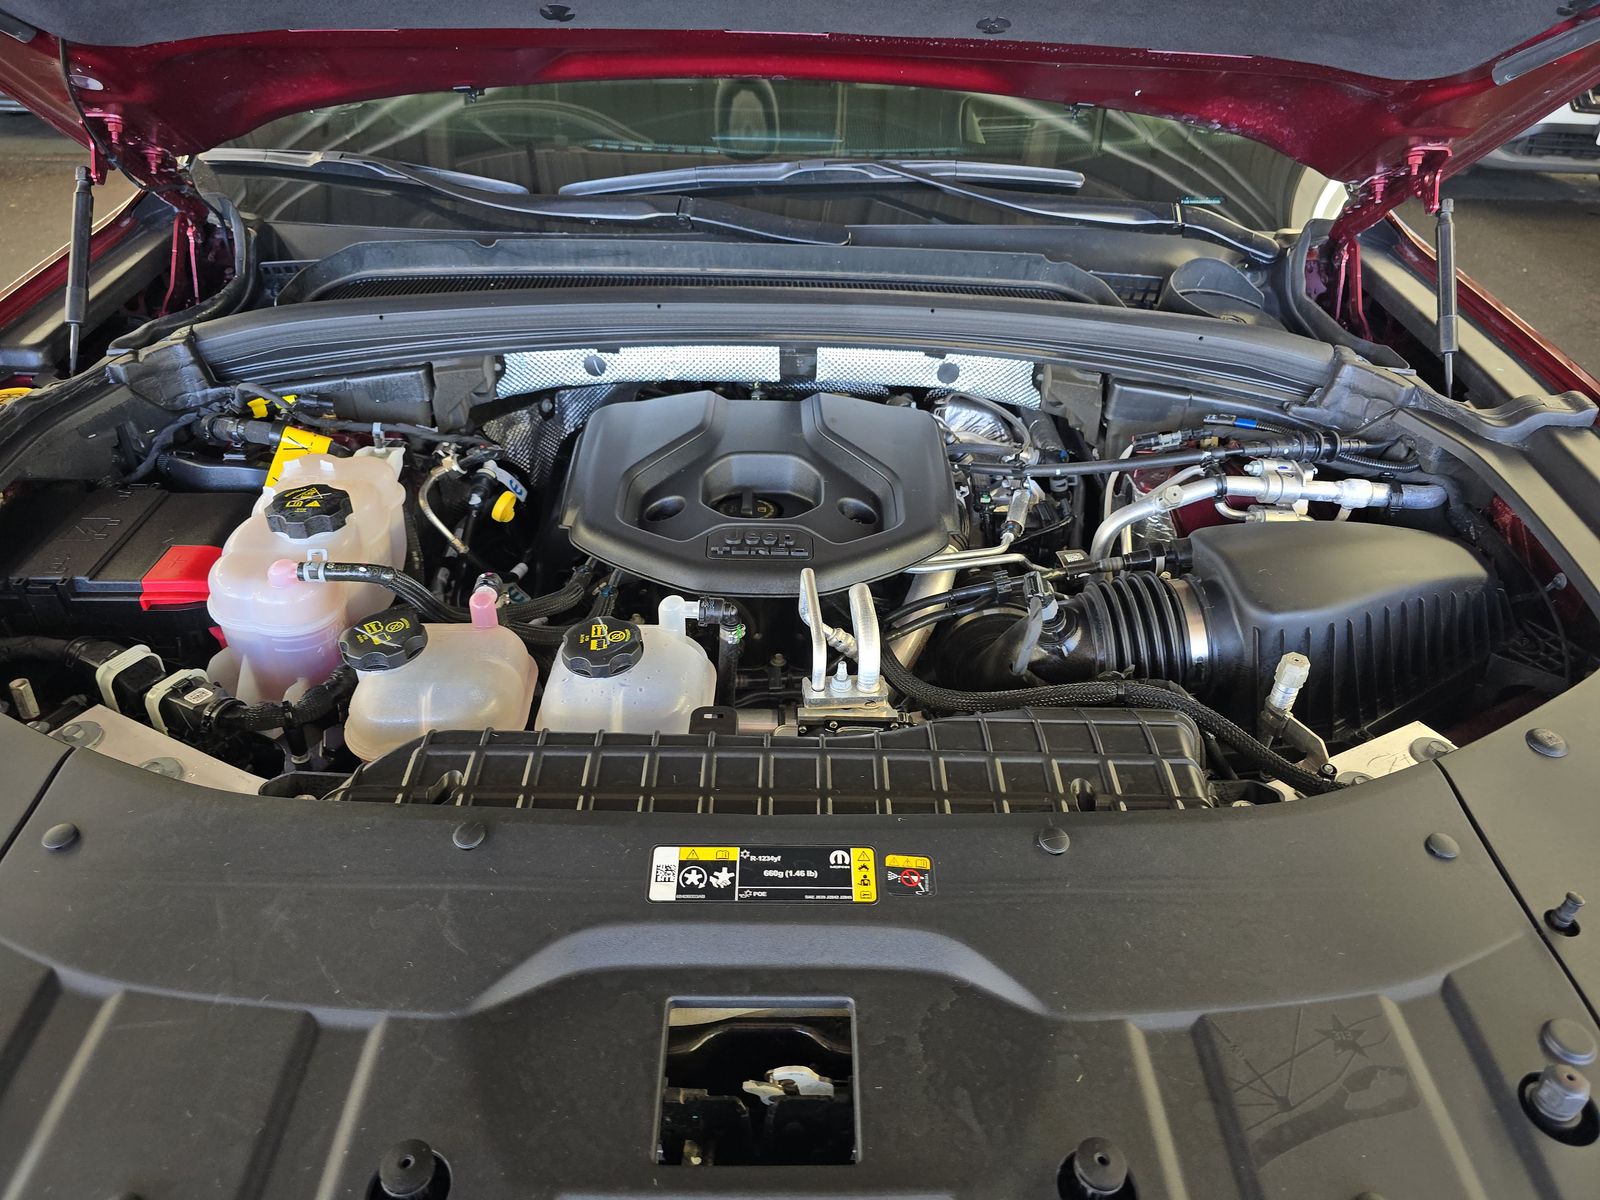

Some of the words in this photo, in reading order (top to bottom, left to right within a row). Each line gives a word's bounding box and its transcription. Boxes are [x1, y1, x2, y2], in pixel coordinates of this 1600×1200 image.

[724, 527, 795, 547] Jeep
[711, 546, 809, 557] TURBO
[750, 855, 781, 863] R-1234yf
[785, 869, 805, 878] (1.46
[806, 869, 818, 878] lb)
